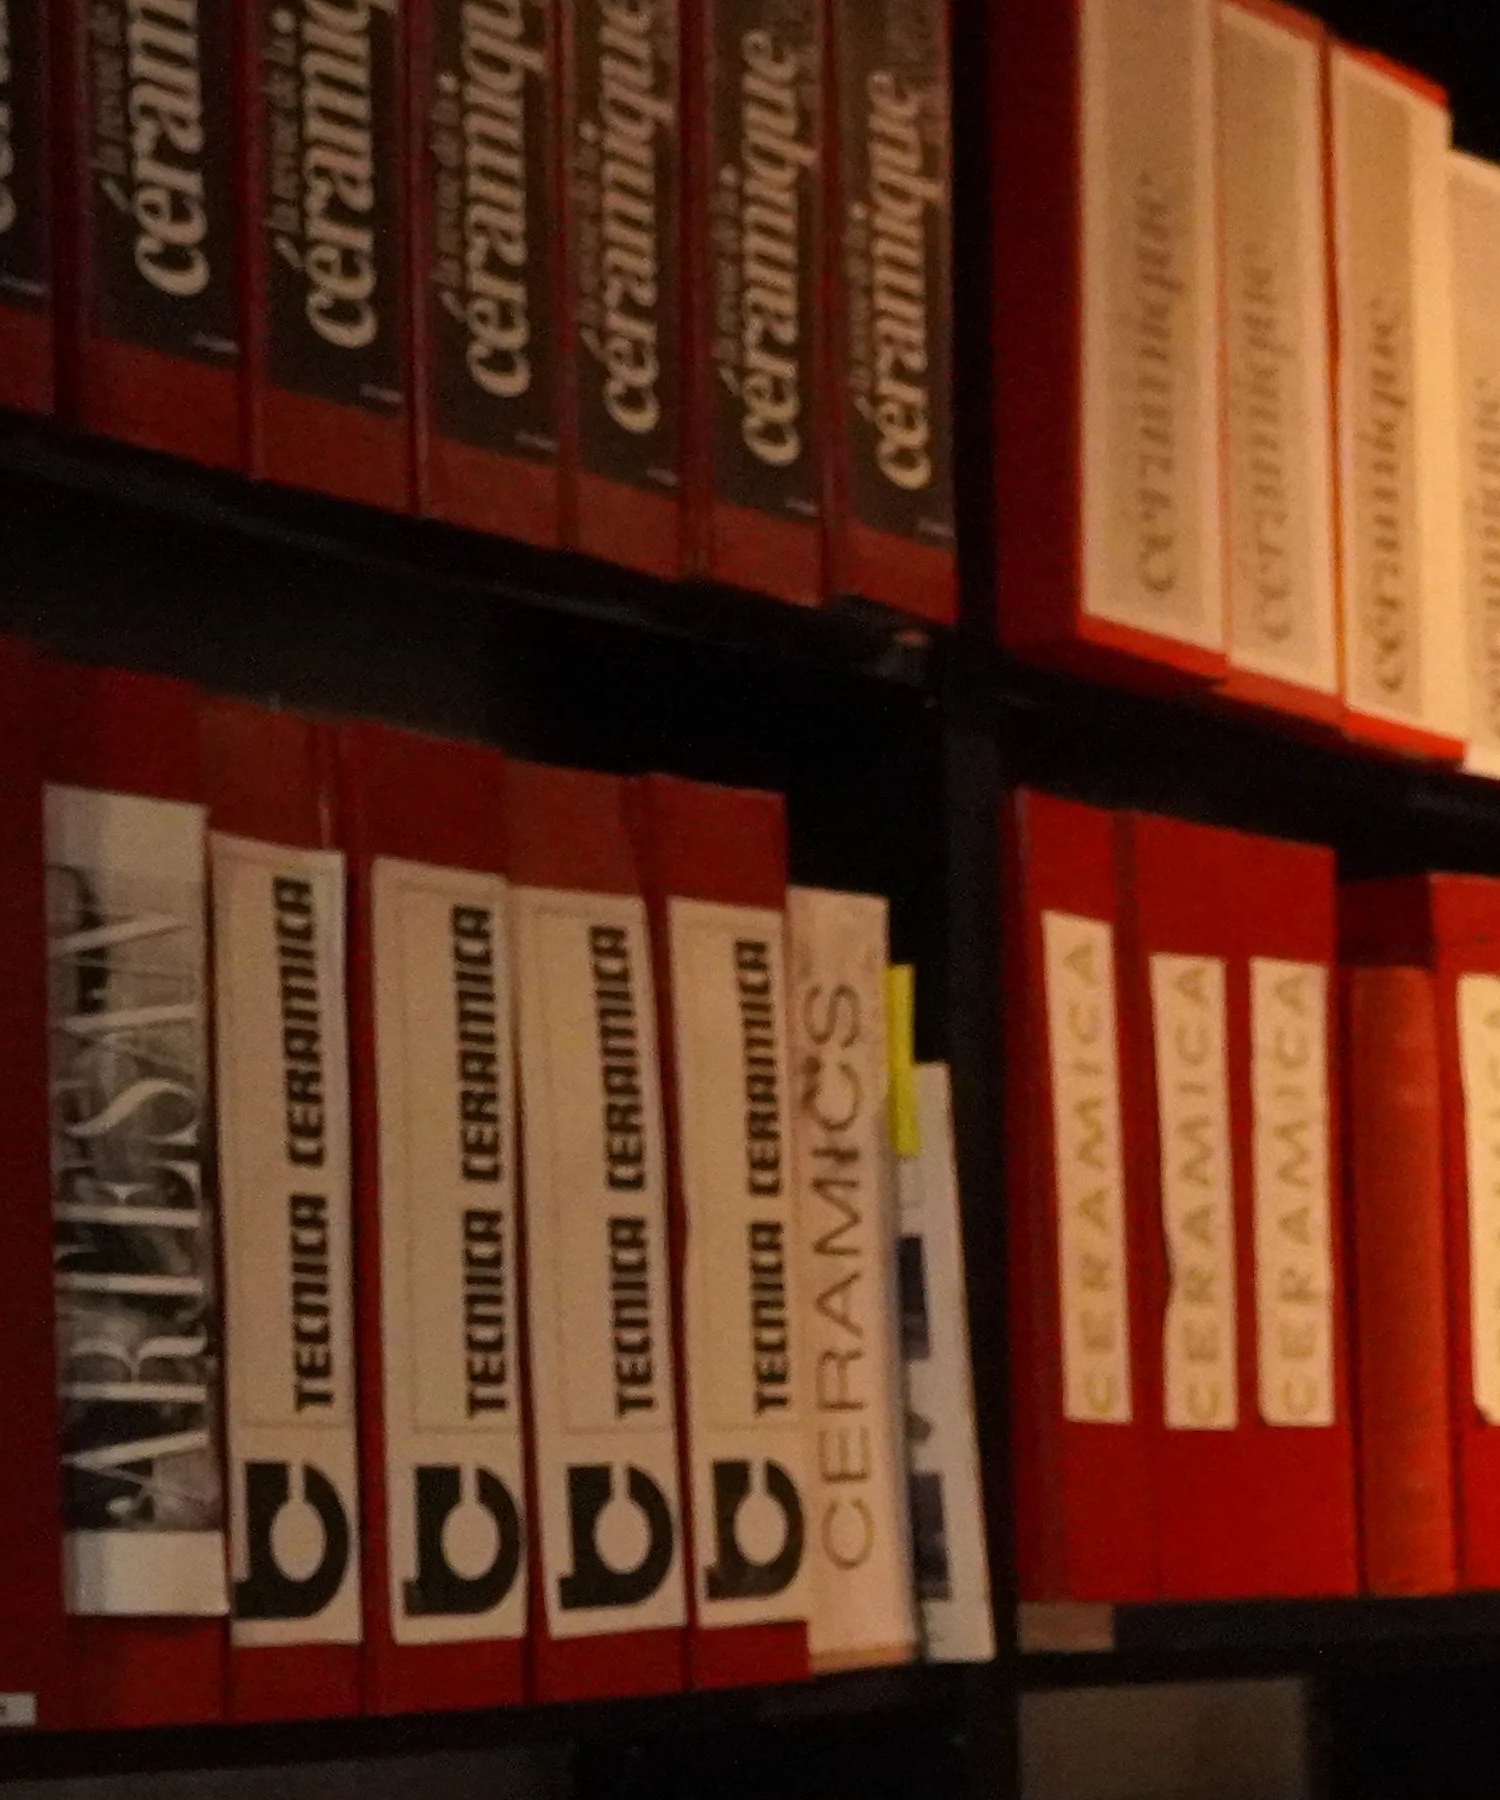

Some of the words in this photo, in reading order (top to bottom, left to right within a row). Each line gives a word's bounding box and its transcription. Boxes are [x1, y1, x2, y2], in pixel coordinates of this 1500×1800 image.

[719, 28, 817, 466] céramique
[852, 69, 946, 490] céramique
[274, 878, 330, 1167] CERAMICA
[453, 904, 500, 1184] CERAMICA
[590, 925, 646, 1190] CERAMICA
[733, 939, 784, 1196] CERAMICA
[291, 1195, 336, 1411] TECNICA
[463, 1209, 507, 1418] TECNICA
[612, 1217, 656, 1418] TECNICA
[751, 1220, 792, 1413] TECNICA
[803, 980, 874, 1570] CERAMICS
[1062, 937, 1118, 1414] CERAMICA
[1172, 960, 1226, 1424] CERAMICA
[1270, 969, 1322, 1416] CERAMICA
